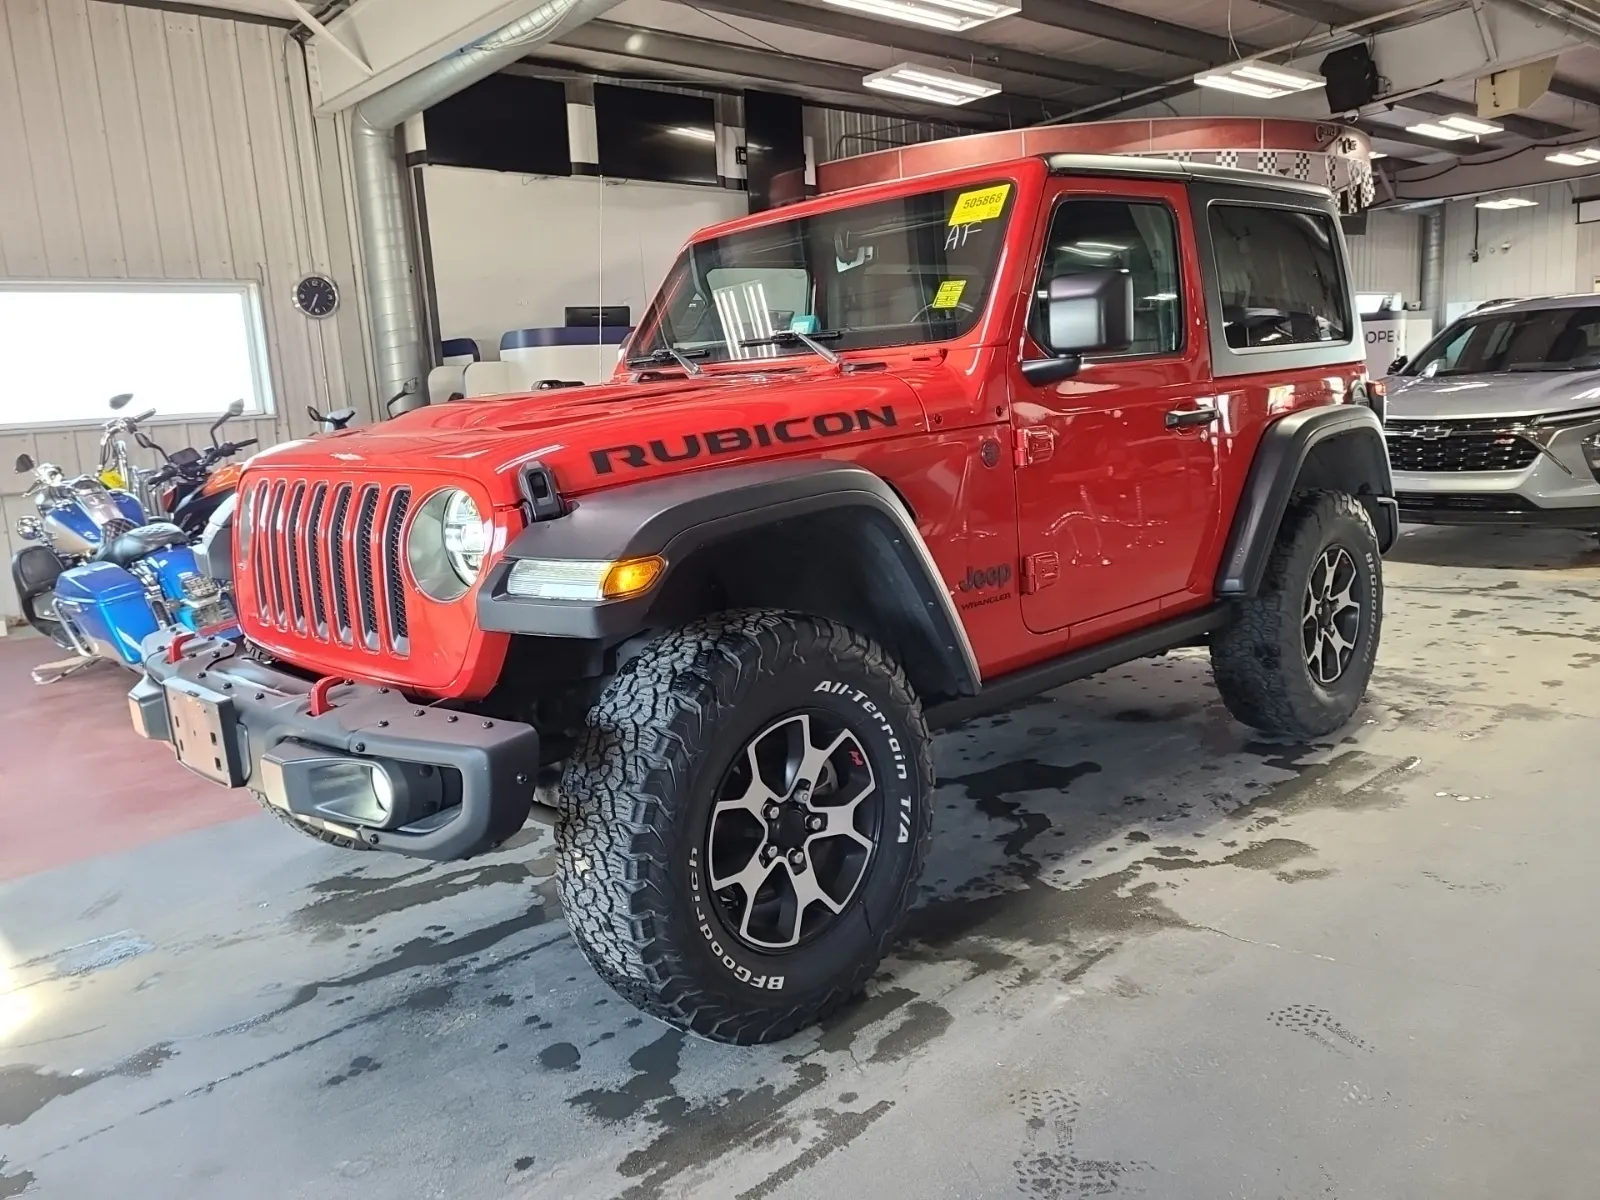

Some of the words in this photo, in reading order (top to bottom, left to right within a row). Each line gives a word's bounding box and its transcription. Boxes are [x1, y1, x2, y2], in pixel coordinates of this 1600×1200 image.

[963, 192, 1003, 210] 505868
[589, 405, 898, 475] RUBICON
[959, 563, 1012, 592] Jeep
[961, 592, 1012, 611] WRANGLER
[813, 680, 908, 780] All-Terrain
[897, 795, 913, 844] T/A
[688, 847, 786, 991] BFGoodrich
